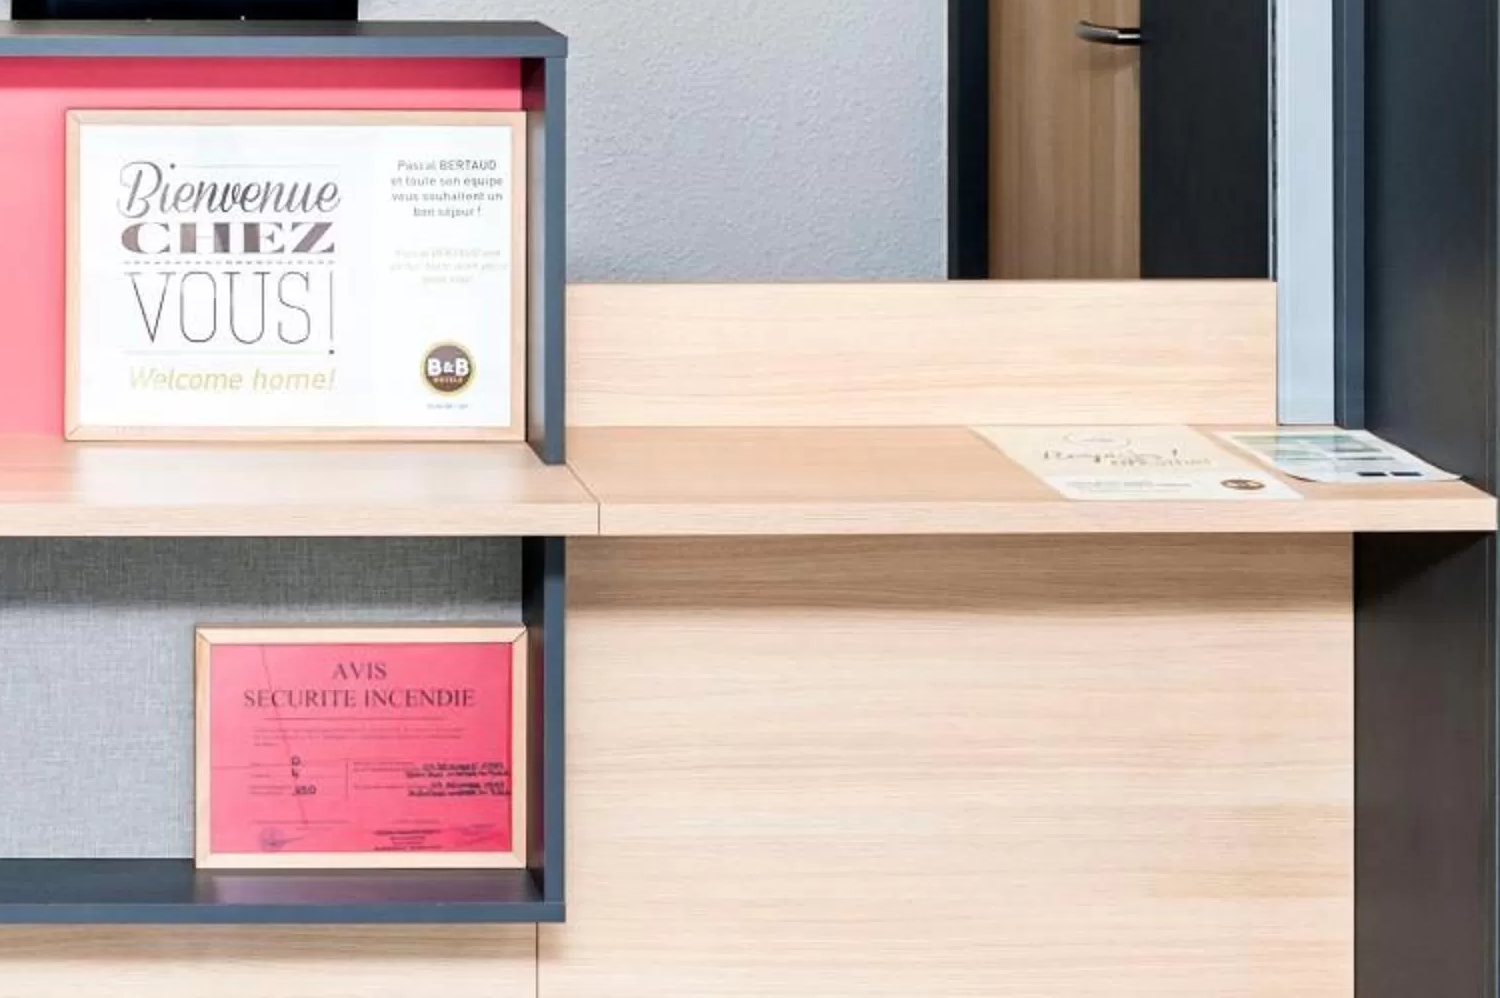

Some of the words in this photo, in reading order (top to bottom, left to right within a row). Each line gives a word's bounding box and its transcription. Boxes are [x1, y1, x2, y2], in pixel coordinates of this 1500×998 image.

[439, 159, 497, 171] BERTAUD
[116, 160, 342, 219] Bienvenue
[120, 221, 336, 254] CHEZ
[427, 357, 470, 377] B&B
[129, 369, 244, 391] Welcome
[253, 368, 337, 391] home!
[331, 661, 388, 681] AVIS
[243, 688, 357, 708] SECURITE
[365, 688, 476, 708] INCENDIE
